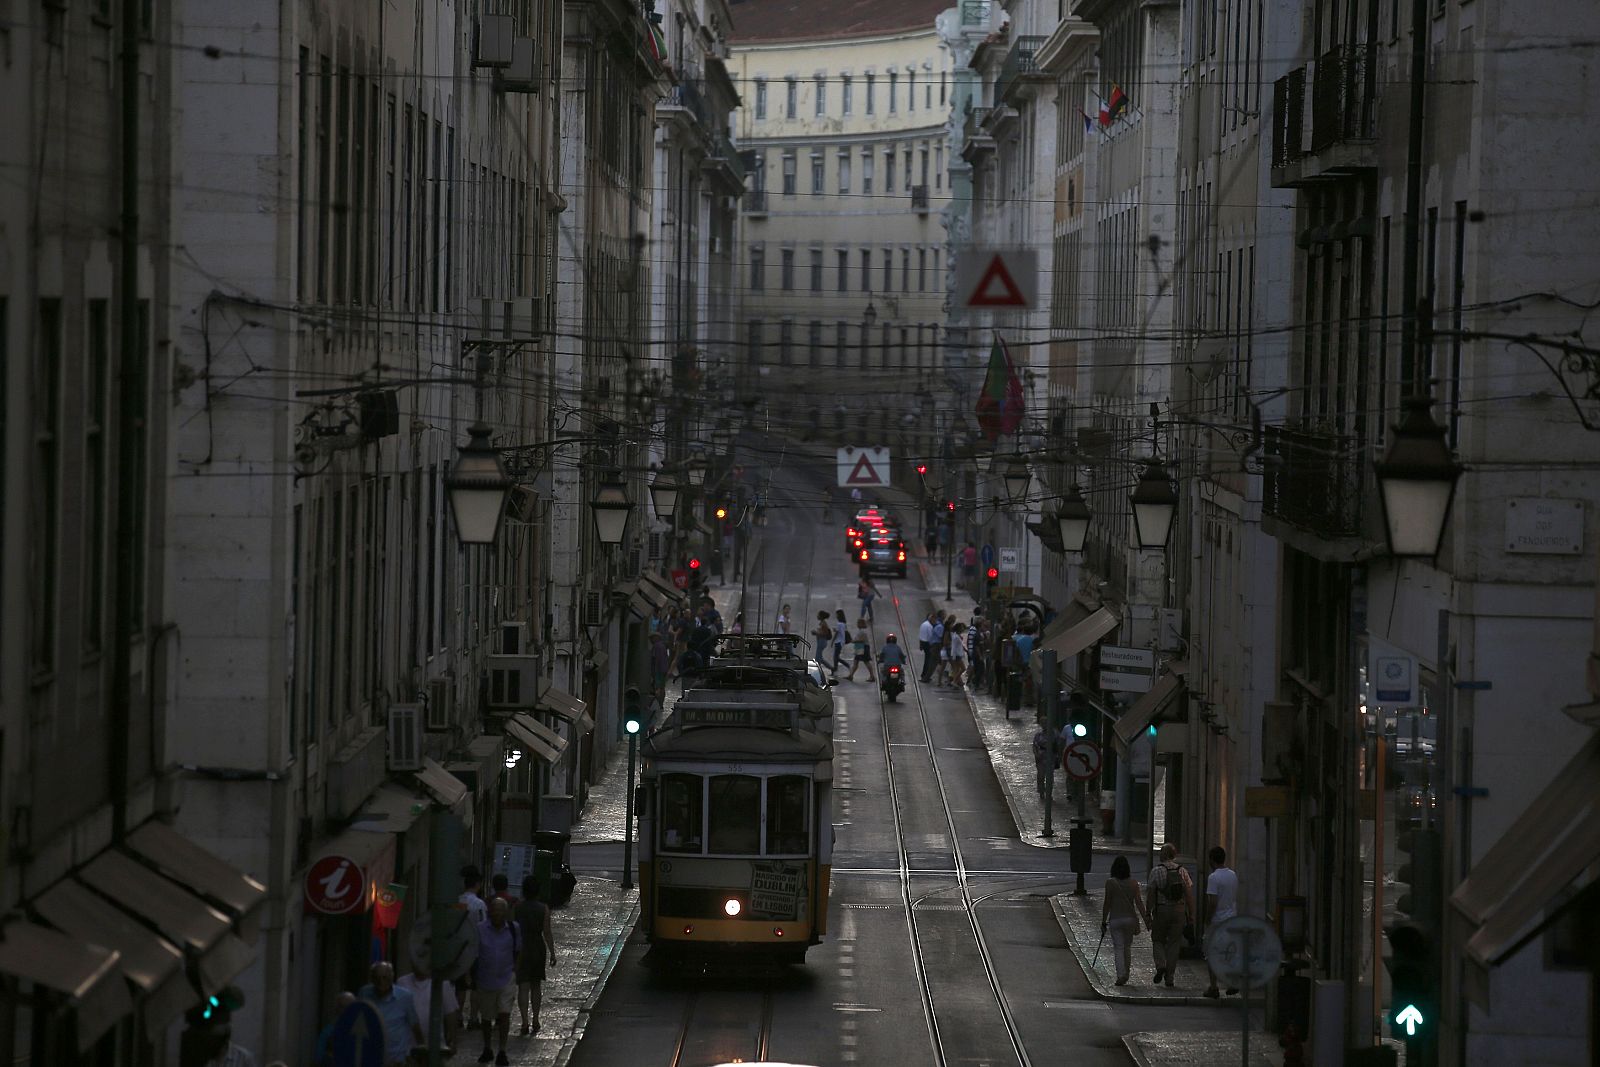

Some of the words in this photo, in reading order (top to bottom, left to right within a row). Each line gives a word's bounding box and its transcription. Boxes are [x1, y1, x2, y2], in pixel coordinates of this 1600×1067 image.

[1101, 650, 1143, 661] Restauradores
[706, 711, 745, 721] MONIZ
[754, 879, 796, 893] DUBLIN
